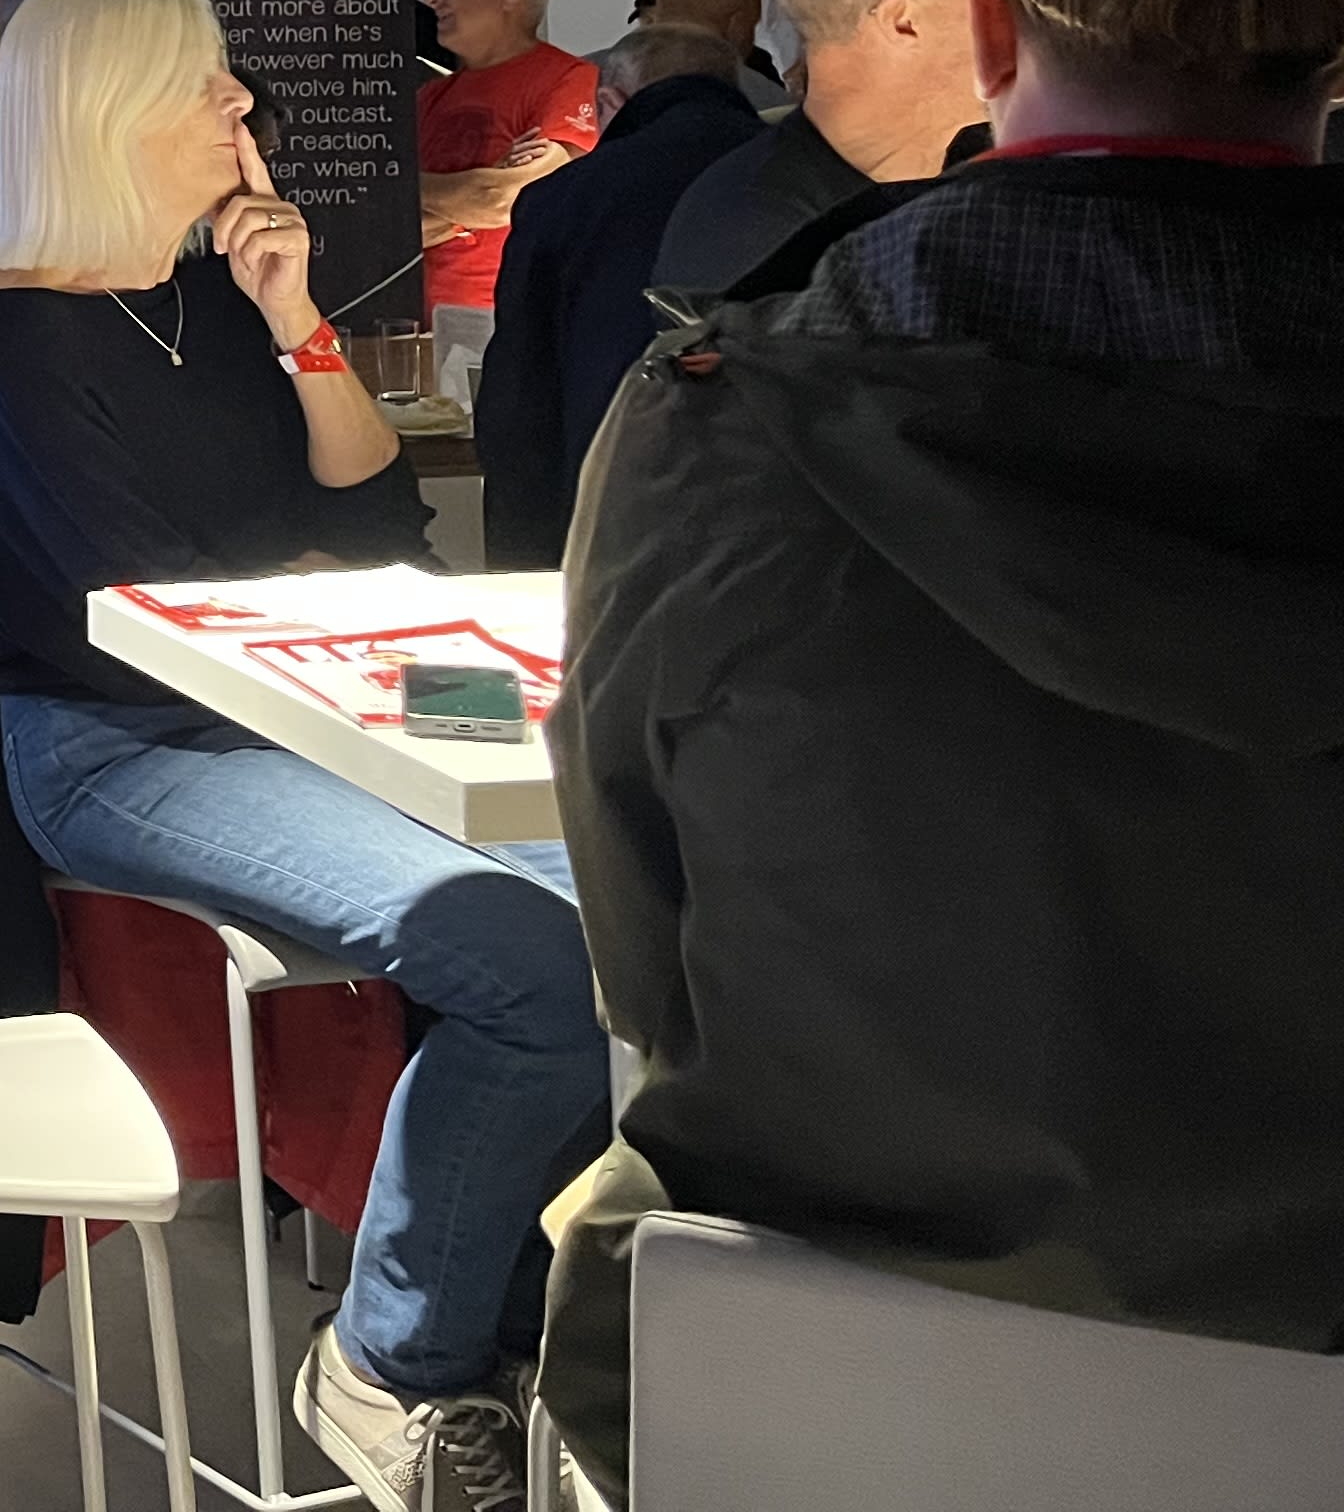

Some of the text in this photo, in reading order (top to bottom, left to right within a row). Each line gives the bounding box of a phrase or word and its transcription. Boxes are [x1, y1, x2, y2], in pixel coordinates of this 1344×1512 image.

[261, 0, 326, 17] more
[223, 24, 382, 45] er when he's
[342, 50, 404, 70] much
[301, 103, 393, 124] outcast.
[313, 158, 378, 177] when
[384, 159, 401, 177] a
